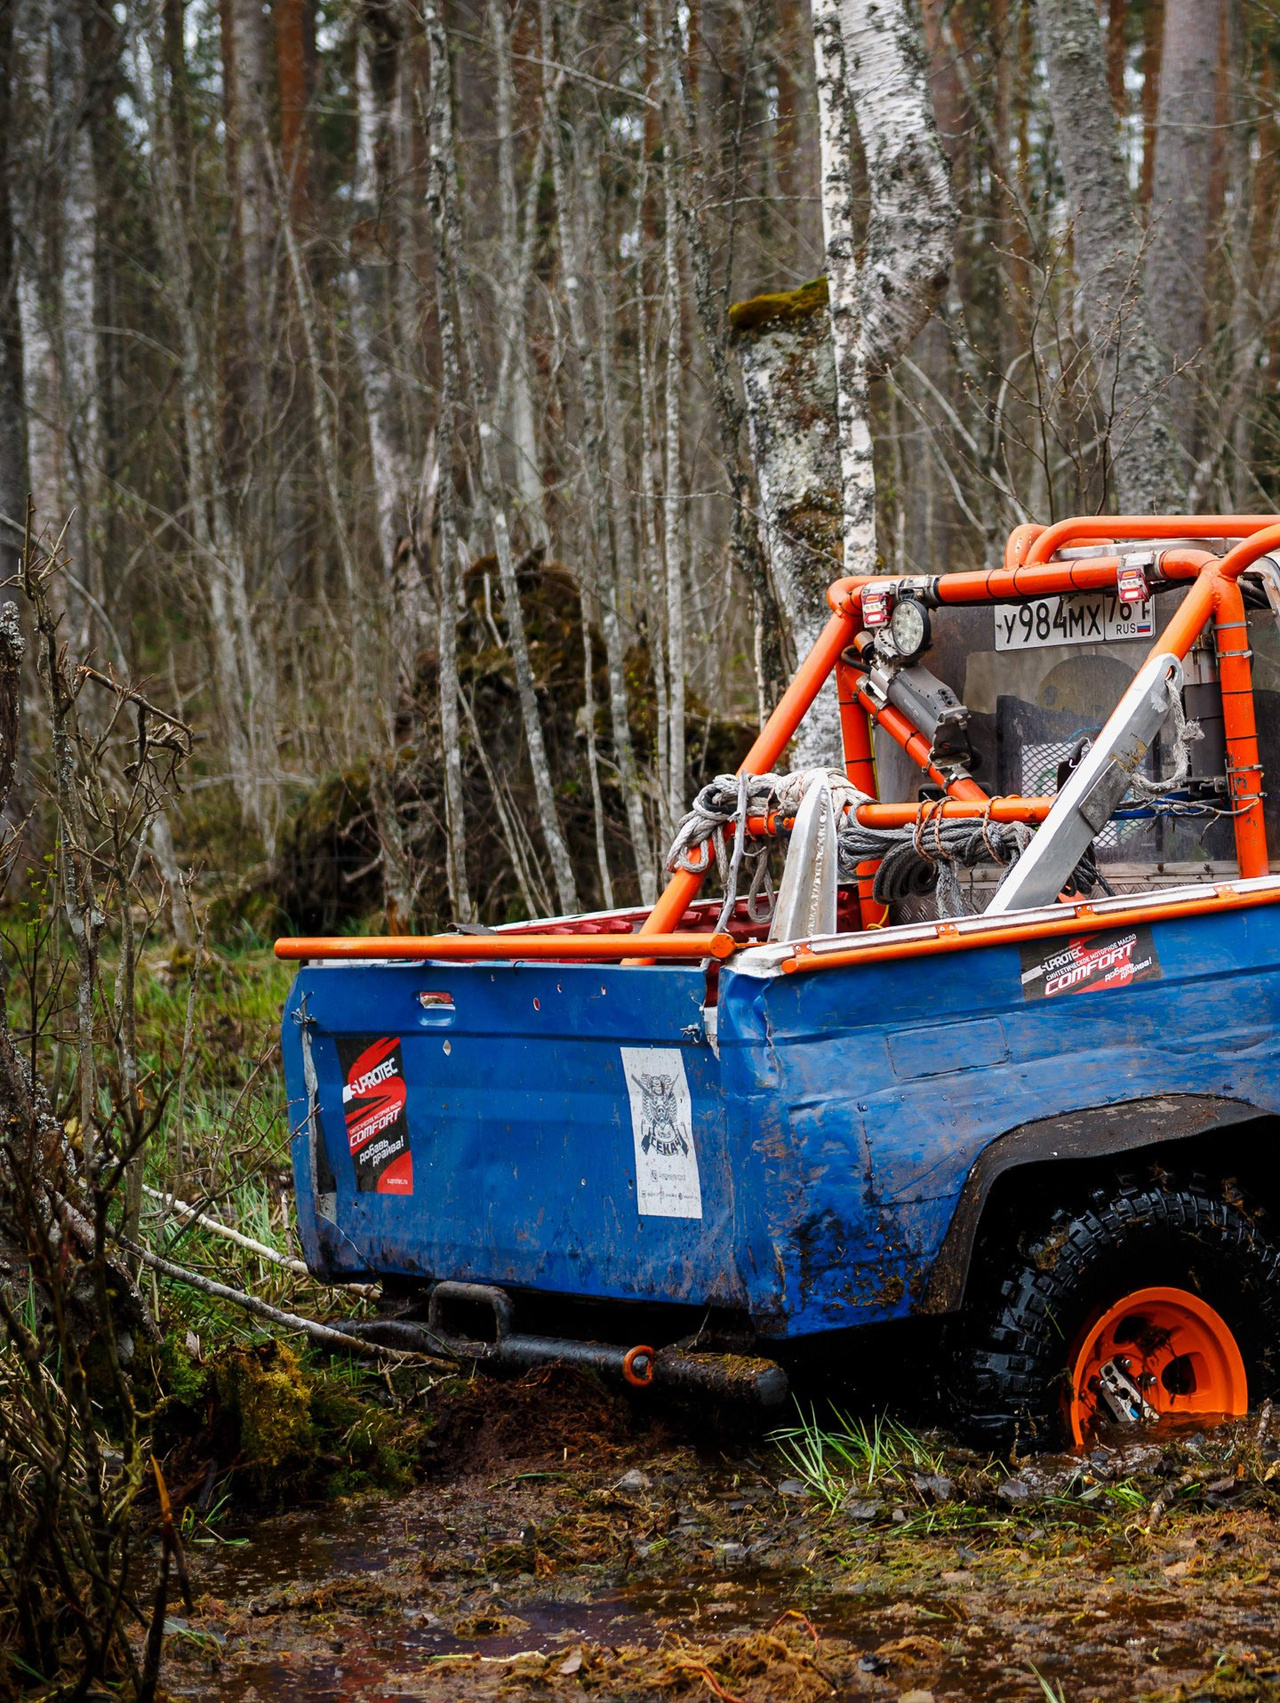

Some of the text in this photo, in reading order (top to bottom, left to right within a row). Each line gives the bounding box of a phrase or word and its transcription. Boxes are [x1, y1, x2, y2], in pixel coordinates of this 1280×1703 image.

[1116, 622, 1136, 635] RUS
[1118, 933, 1137, 947] МАСЛО
[1044, 940, 1137, 996] COMFORT
[349, 1057, 399, 1095] SUPROTEC
[350, 1107, 402, 1147] COMFORT
[650, 1135, 682, 1154] СЕКАЧ
